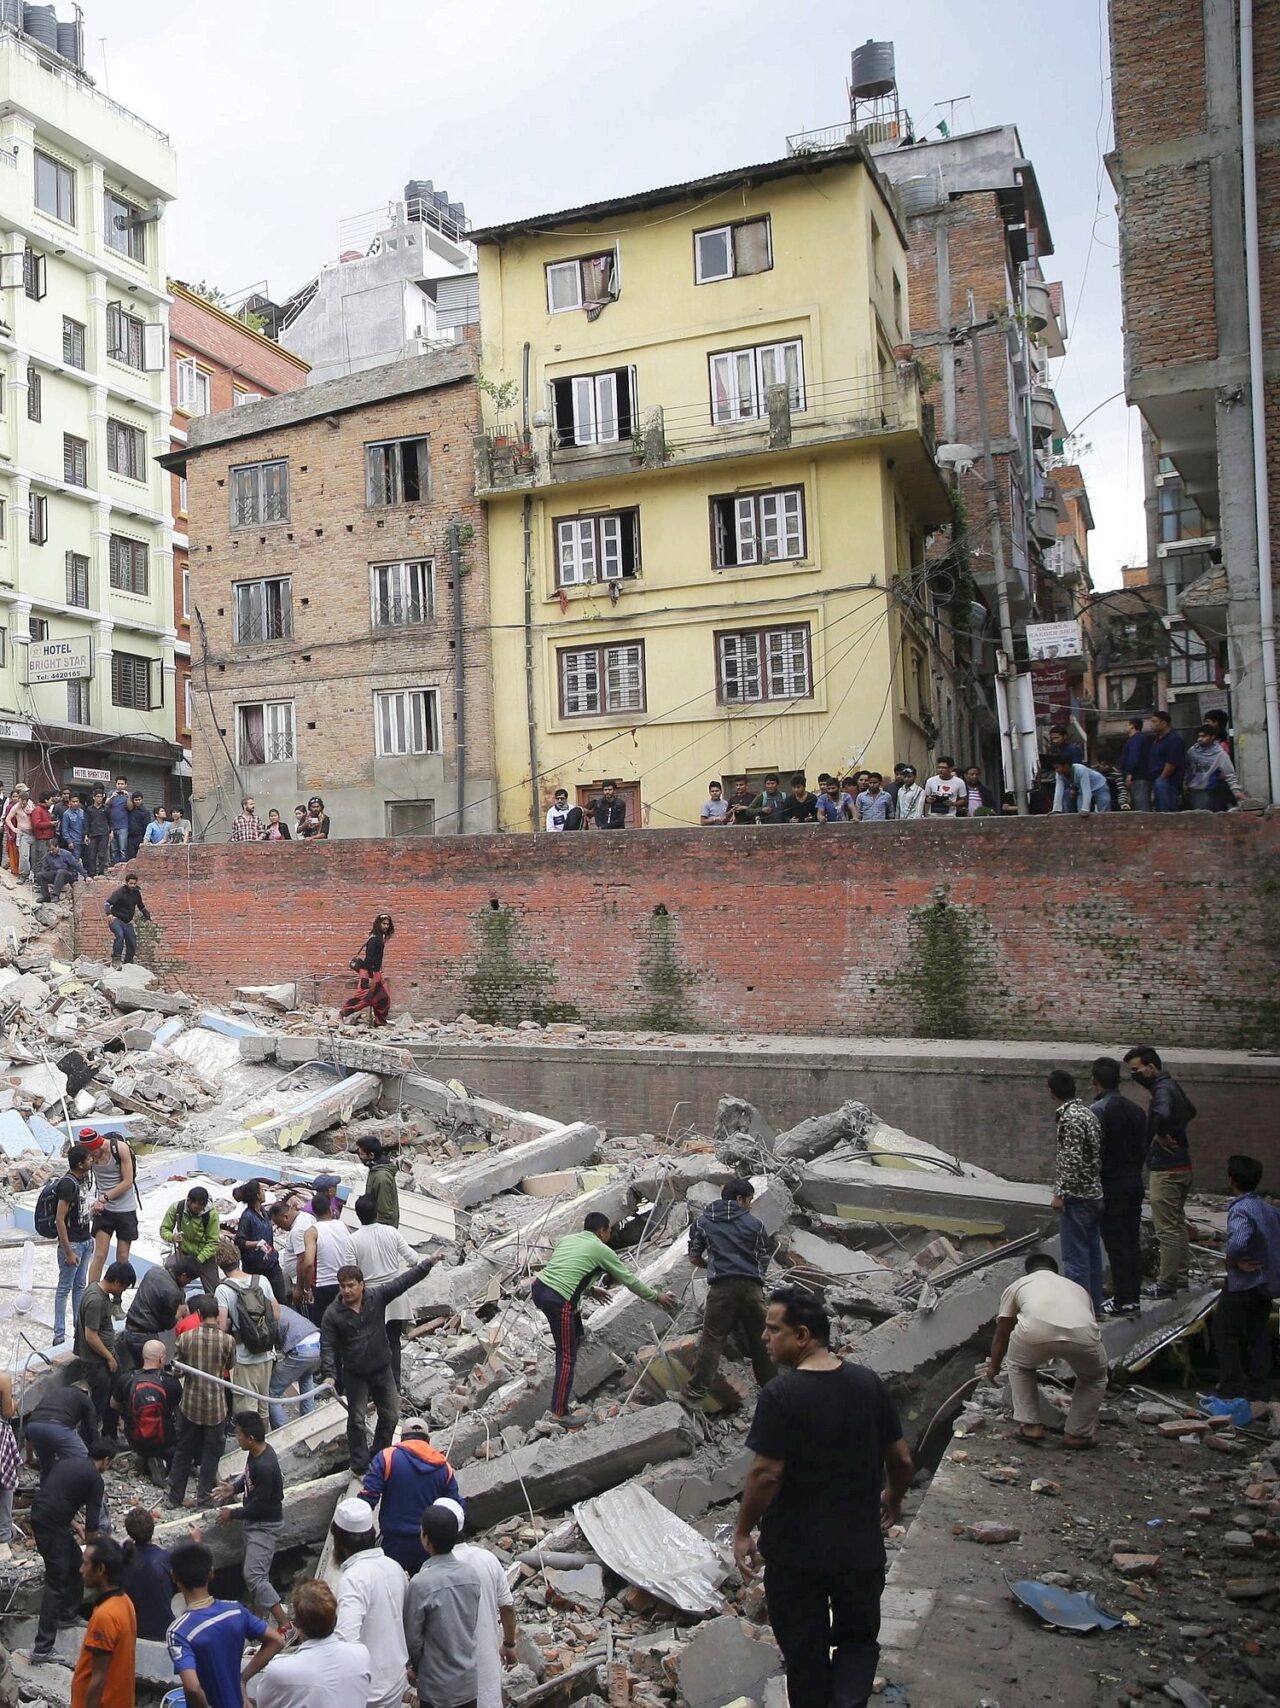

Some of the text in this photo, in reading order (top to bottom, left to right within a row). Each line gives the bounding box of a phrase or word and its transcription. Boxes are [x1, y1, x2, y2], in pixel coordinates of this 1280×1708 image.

[43, 644, 72, 656] HOTEL
[29, 655, 87, 671] BRIGHT STAR
[51, 671, 81, 679] 4420165
[0, 723, 11, 736] TOURS
[74, 769, 109, 780] HOTEL BRIGHT STAR
